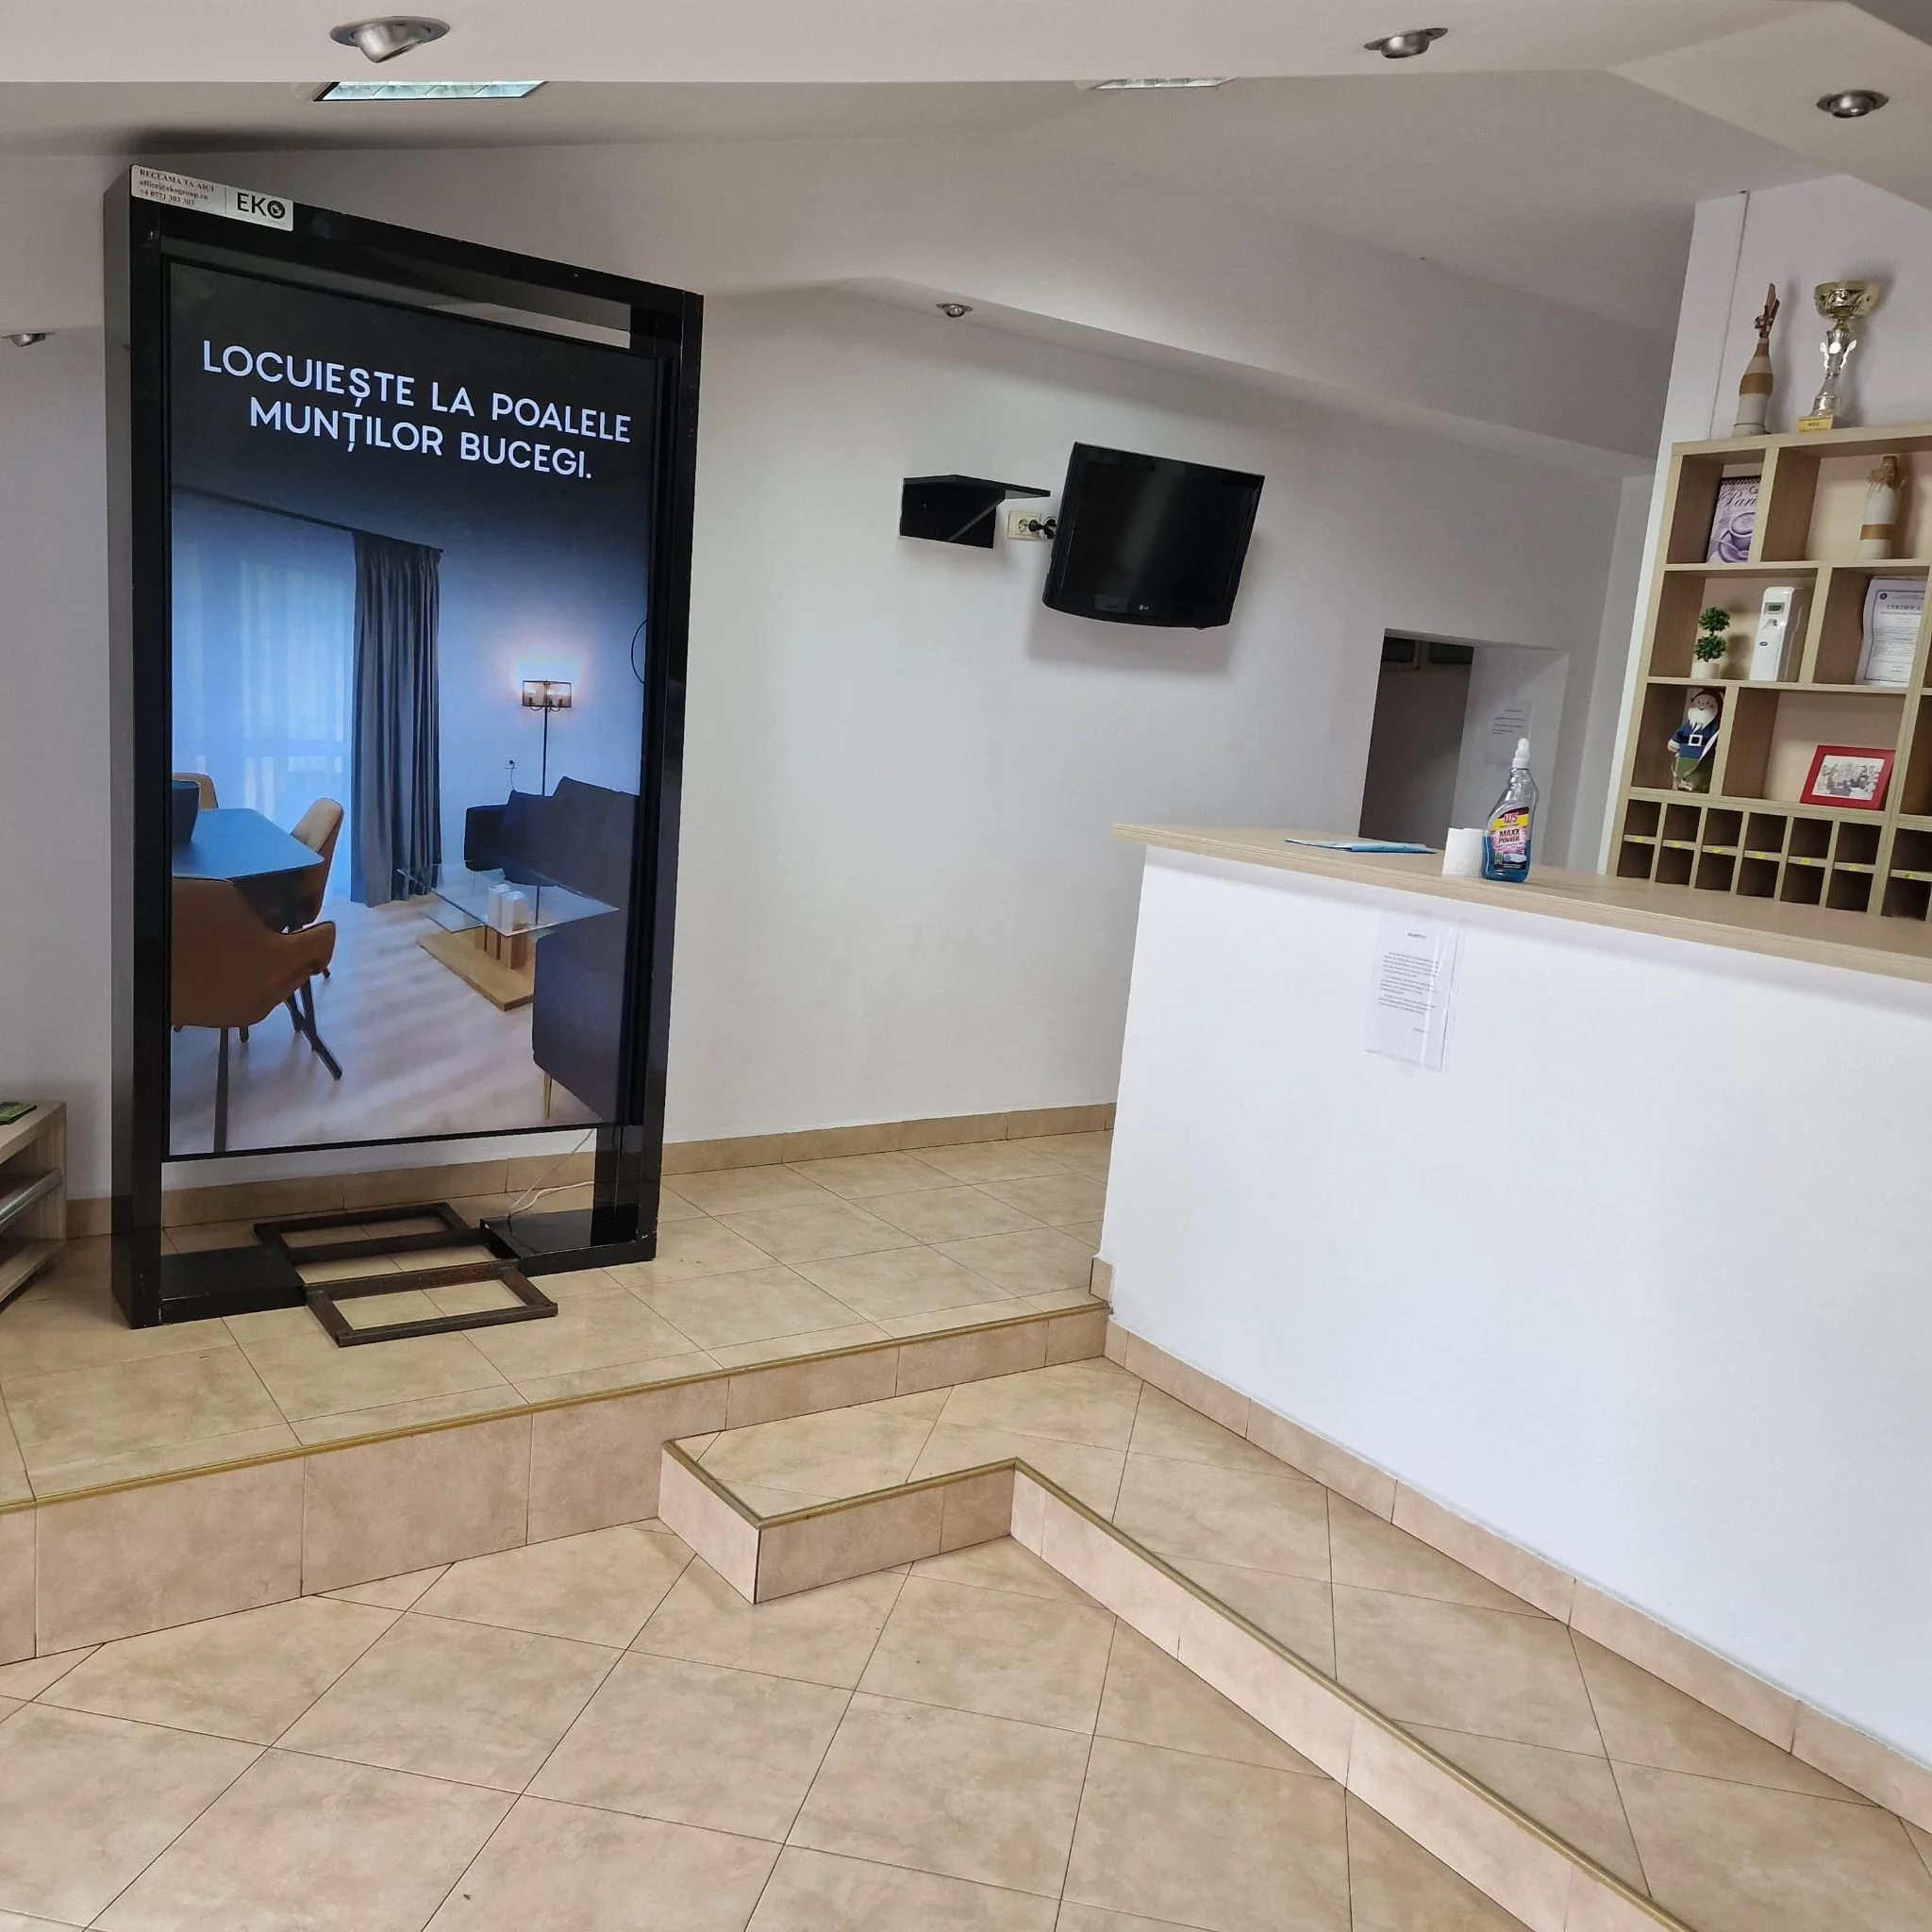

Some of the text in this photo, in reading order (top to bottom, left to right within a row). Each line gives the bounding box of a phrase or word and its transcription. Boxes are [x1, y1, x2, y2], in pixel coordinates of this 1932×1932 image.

[140, 169, 181, 184] RECLAMA
[197, 183, 214, 192] AICI
[203, 340, 632, 443] LOCUIEȘTE LA POALELE
[249, 396, 592, 479] MUNȚILOR BUCEGI.
[1498, 835, 1520, 844] POWER
[1499, 829, 1520, 838] MAXX
